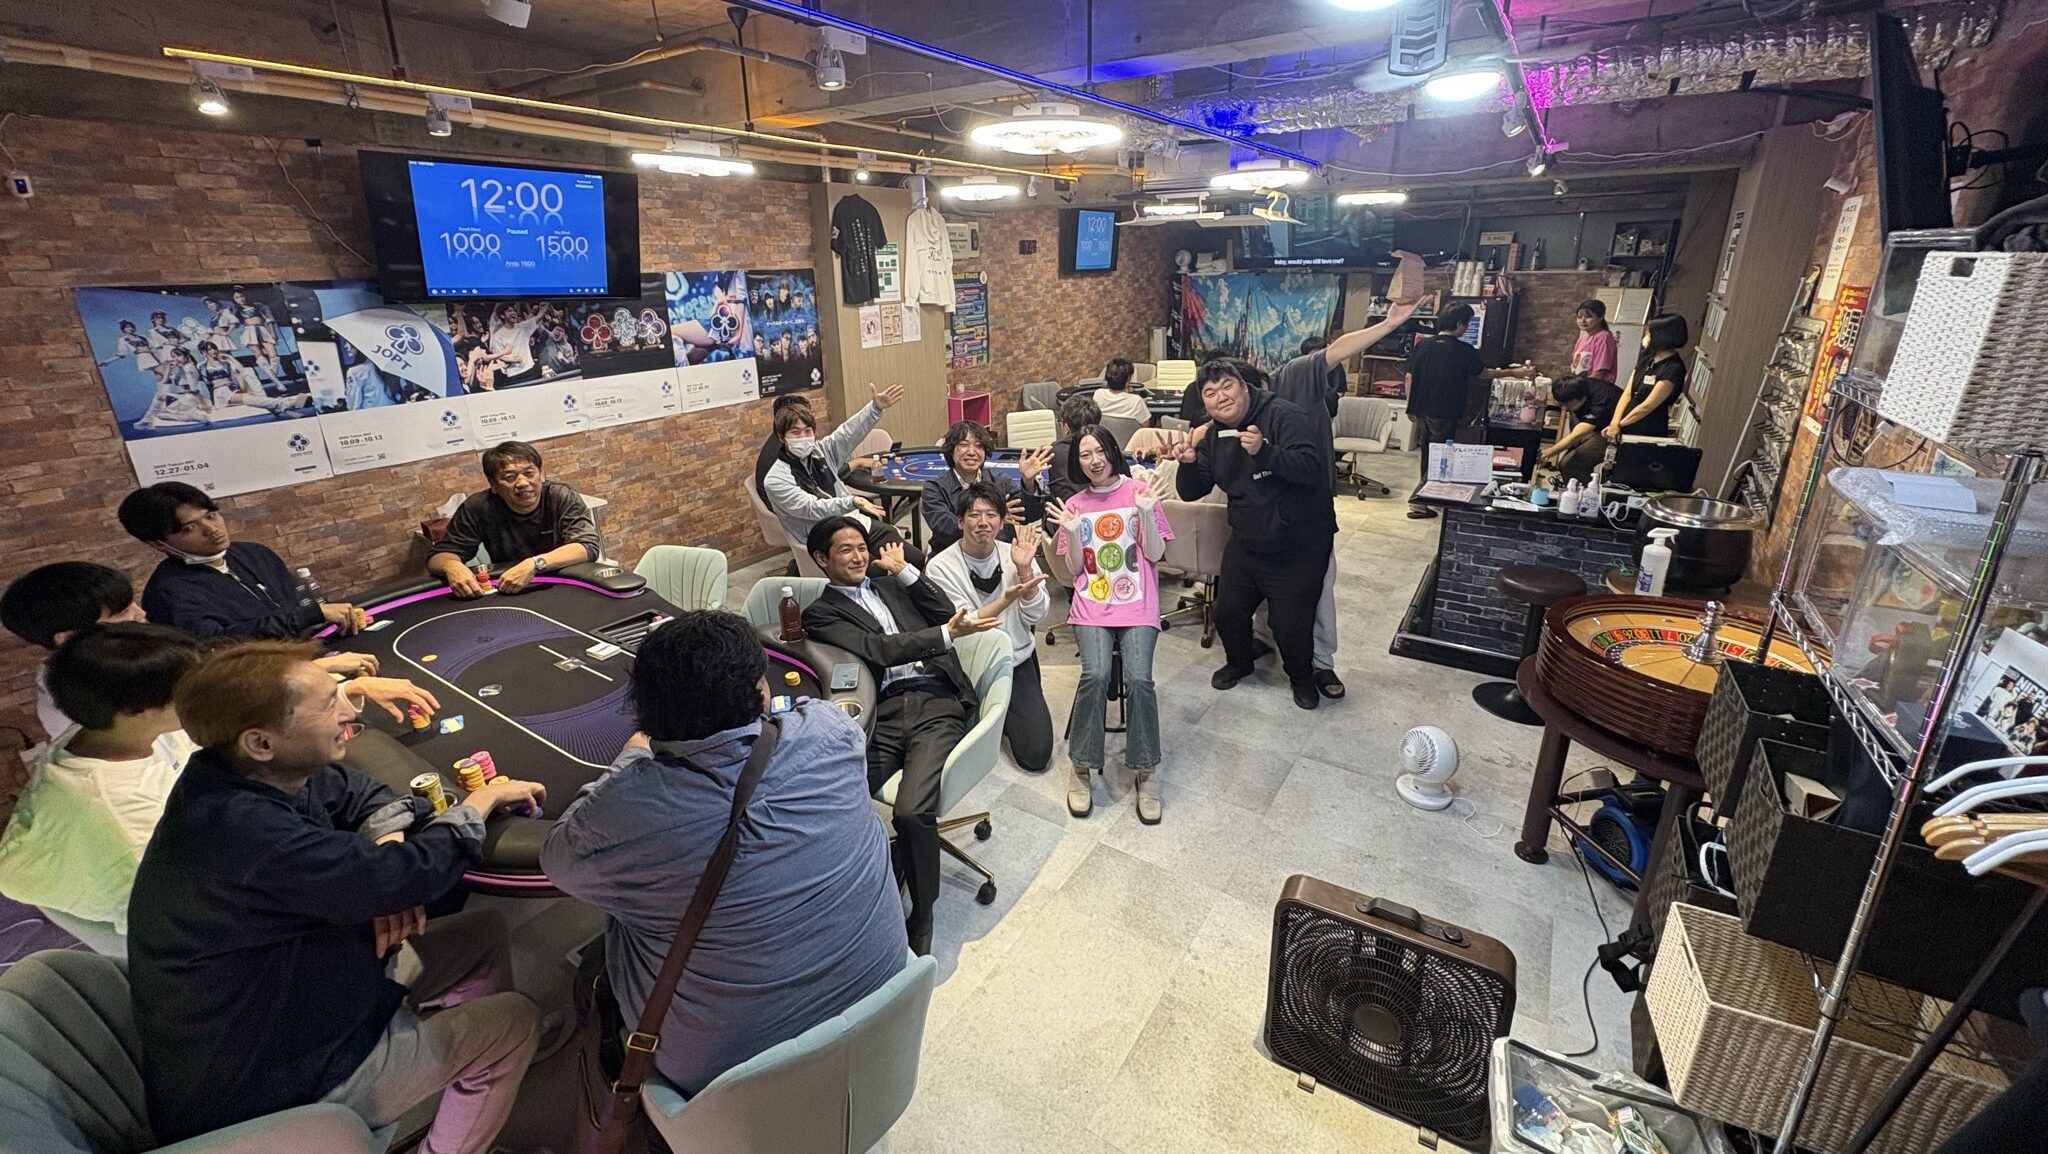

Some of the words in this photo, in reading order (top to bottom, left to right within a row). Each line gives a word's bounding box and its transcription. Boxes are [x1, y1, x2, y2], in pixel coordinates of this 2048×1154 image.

[461, 178, 563, 214] 12:00
[440, 232, 500, 253] 1000
[536, 236, 589, 254] 1500
[370, 344, 412, 370] JOPT
[1613, 630, 1624, 640] 9
[1622, 629, 1636, 639] 26
[1634, 628, 1648, 639] 30
[1649, 629, 1662, 639] 11
[1667, 630, 1675, 640] 7
[1679, 632, 1694, 643] 20
[1729, 645, 1738, 654] 5
